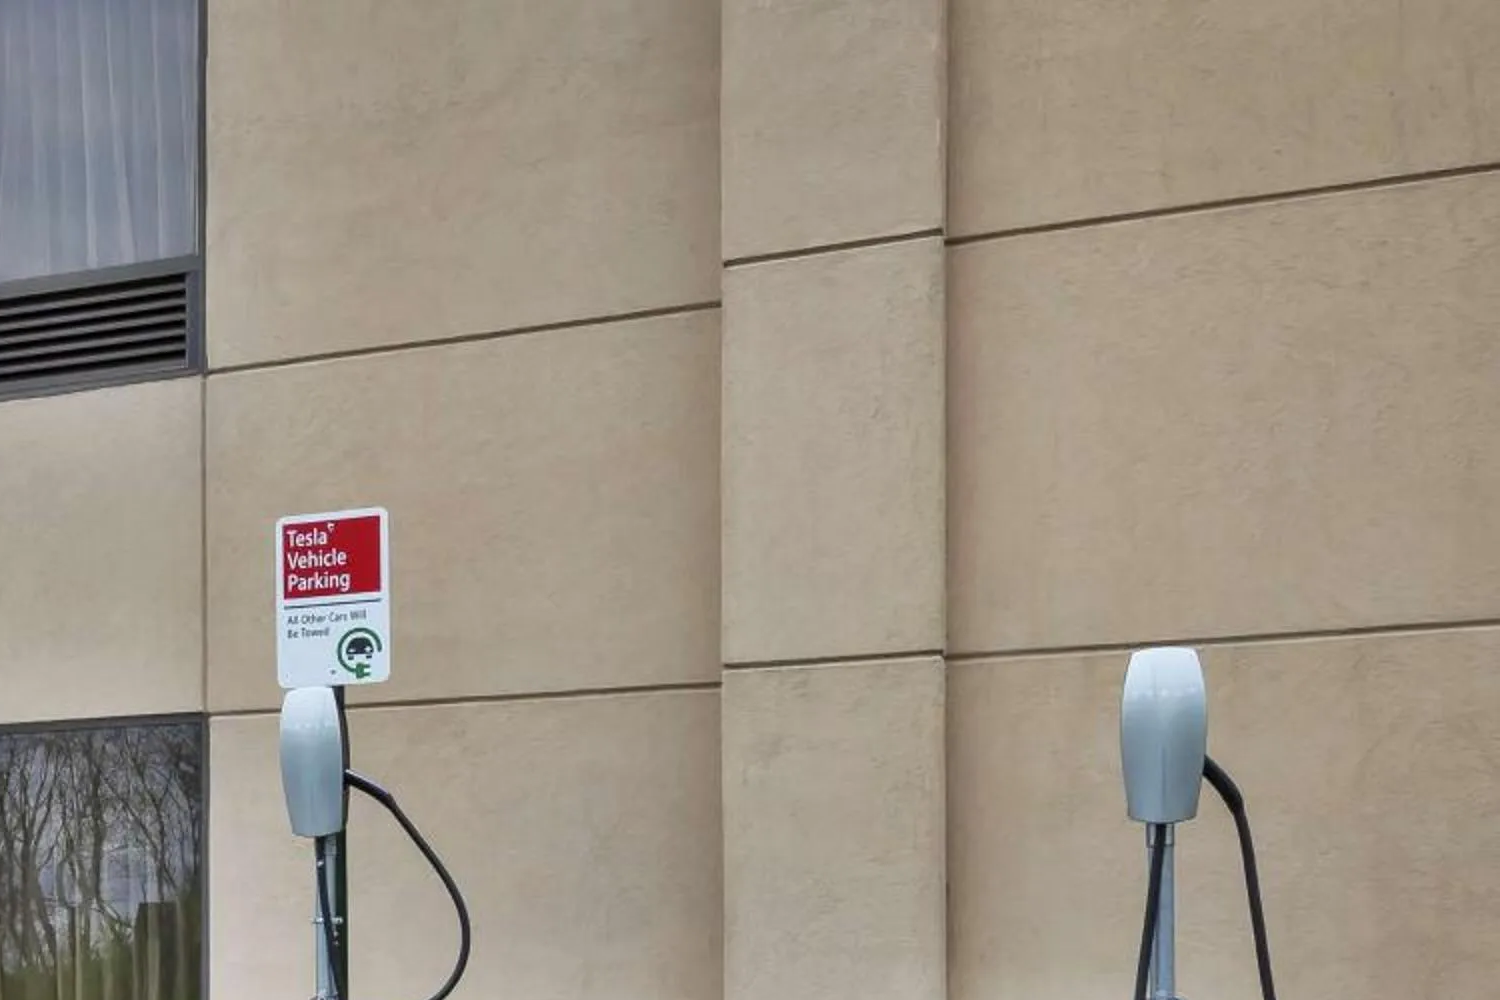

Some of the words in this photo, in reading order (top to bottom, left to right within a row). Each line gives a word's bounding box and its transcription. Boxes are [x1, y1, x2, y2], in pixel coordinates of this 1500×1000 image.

[286, 528, 328, 548] Tesla
[287, 547, 347, 569] Vehicle
[288, 571, 351, 592] Parking
[287, 615, 299, 624] All
[301, 613, 326, 624] Other
[329, 611, 347, 622] Cars
[287, 629, 299, 638] Be
[301, 627, 329, 638] Towed
